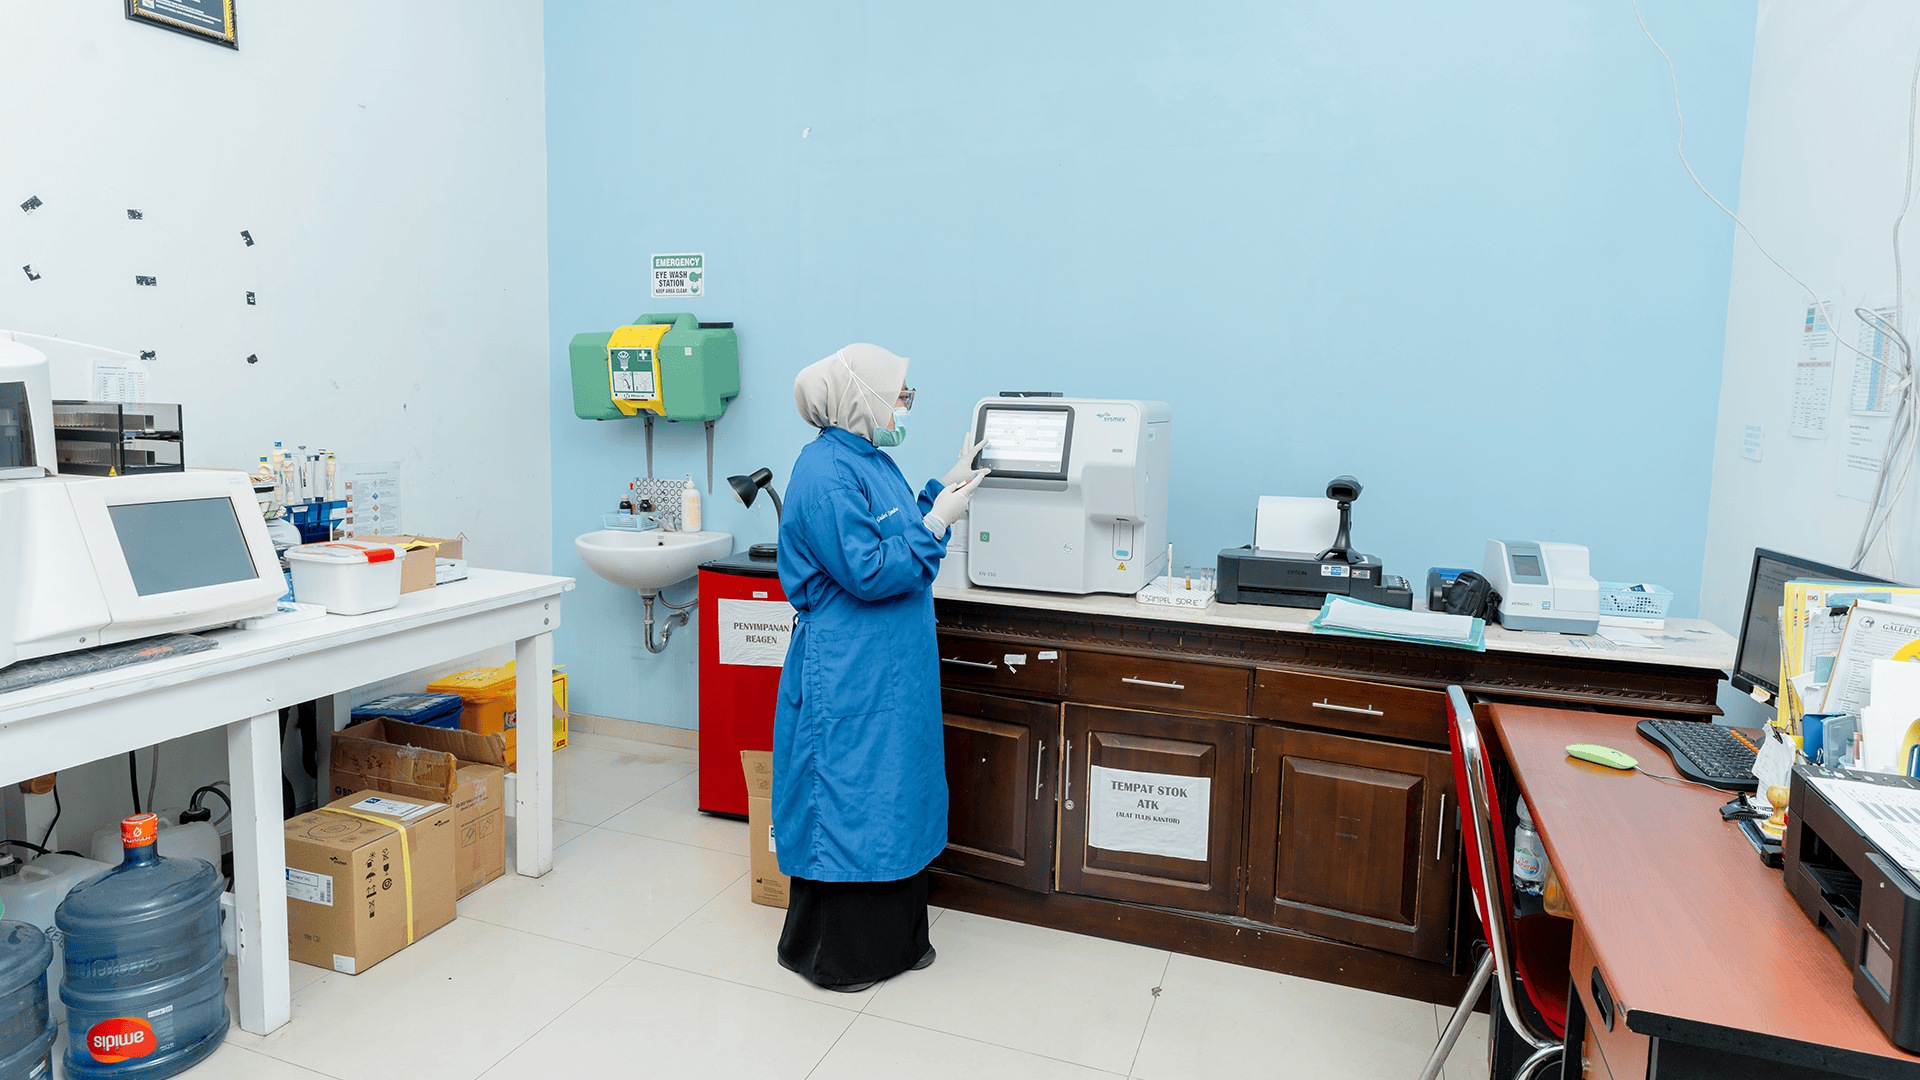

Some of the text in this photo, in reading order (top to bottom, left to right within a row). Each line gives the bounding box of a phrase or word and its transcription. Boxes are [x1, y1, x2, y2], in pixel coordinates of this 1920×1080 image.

[655, 257, 700, 267] EMERGENCY
[655, 270, 688, 279] EYE WASH
[734, 622, 790, 632] PENYIMPANAN
[1882, 624, 1912, 634] GALERI
[746, 634, 777, 644] REAGEN
[1111, 781, 1188, 798] TEMPAT STOK
[1137, 799, 1159, 810] ATK
[1153, 816, 1180, 824] KANTOR)
[93, 1030, 144, 1051] amidis
